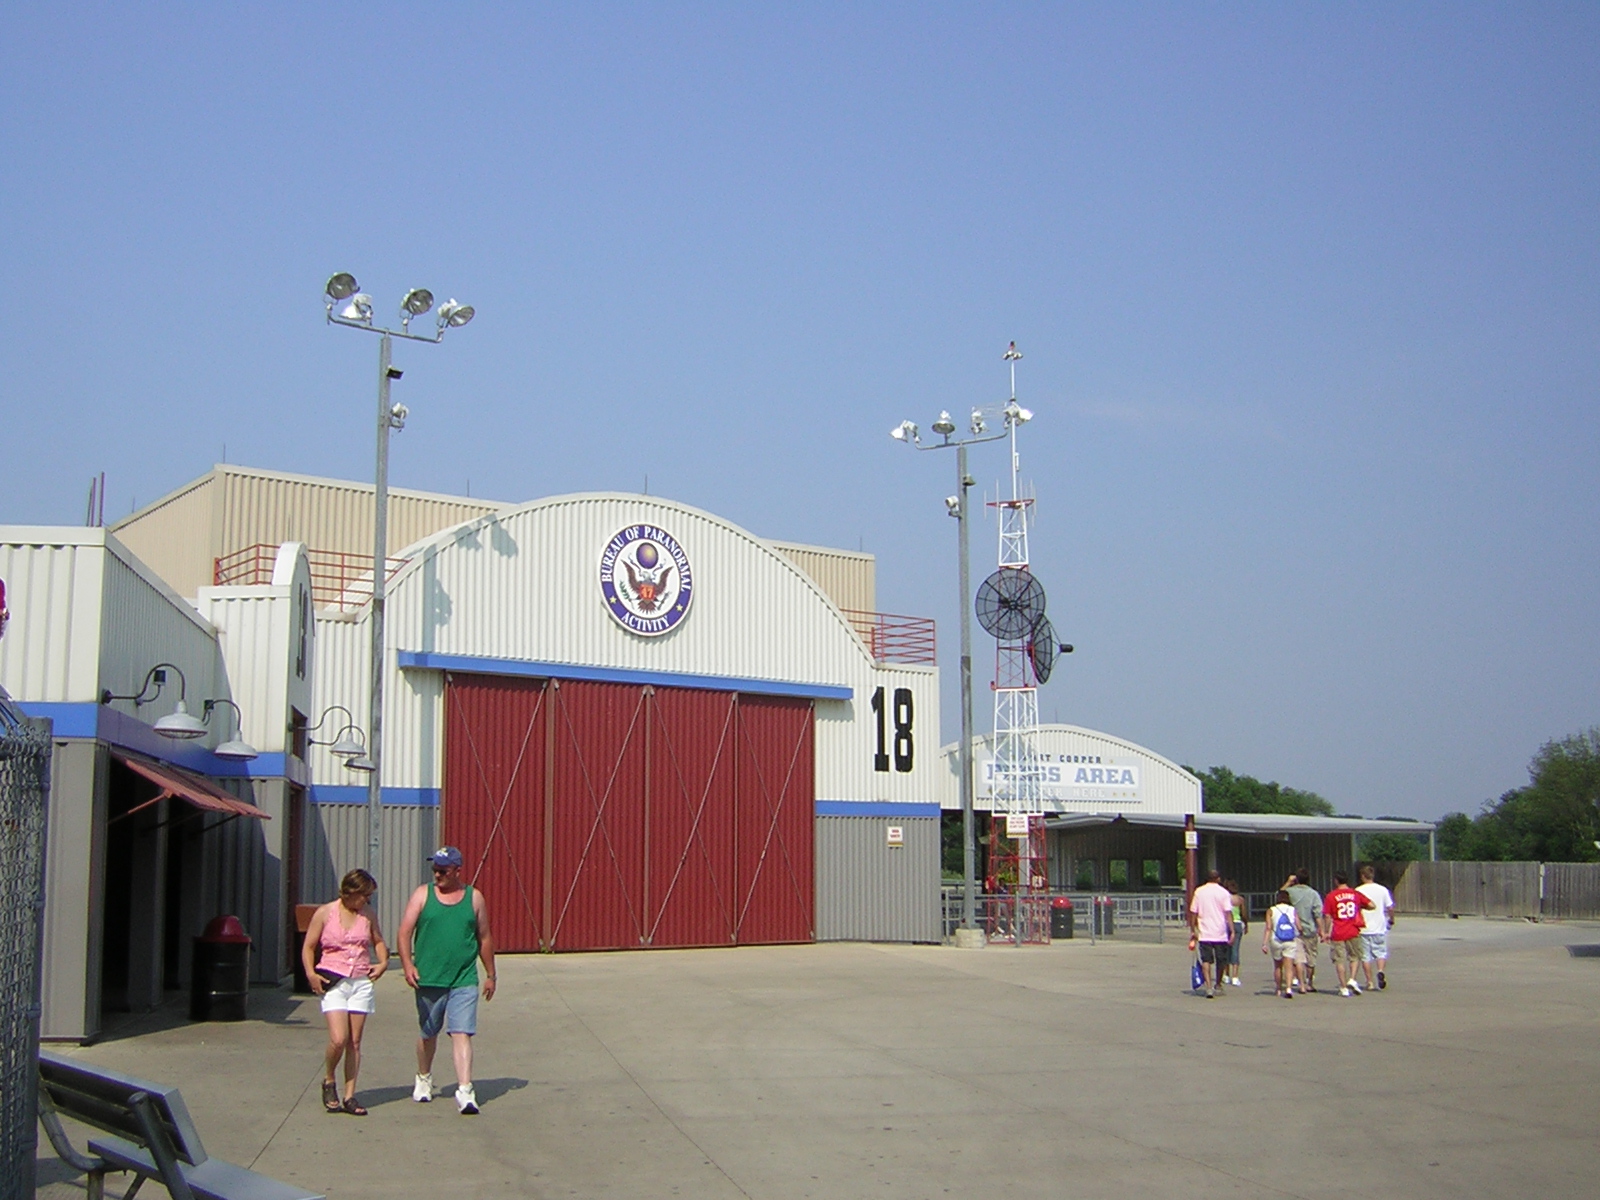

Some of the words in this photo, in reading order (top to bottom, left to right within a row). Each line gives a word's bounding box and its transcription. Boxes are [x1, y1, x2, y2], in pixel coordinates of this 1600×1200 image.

[601, 535, 624, 583] BUREAU
[625, 525, 641, 541] OF
[644, 525, 692, 592] PARANORMAL
[621, 611, 670, 632] ACTIVITY
[871, 686, 914, 773] 18
[1059, 754, 1102, 764] COOPER
[1074, 767, 1135, 785] AREA
[1336, 901, 1356, 919] 28
